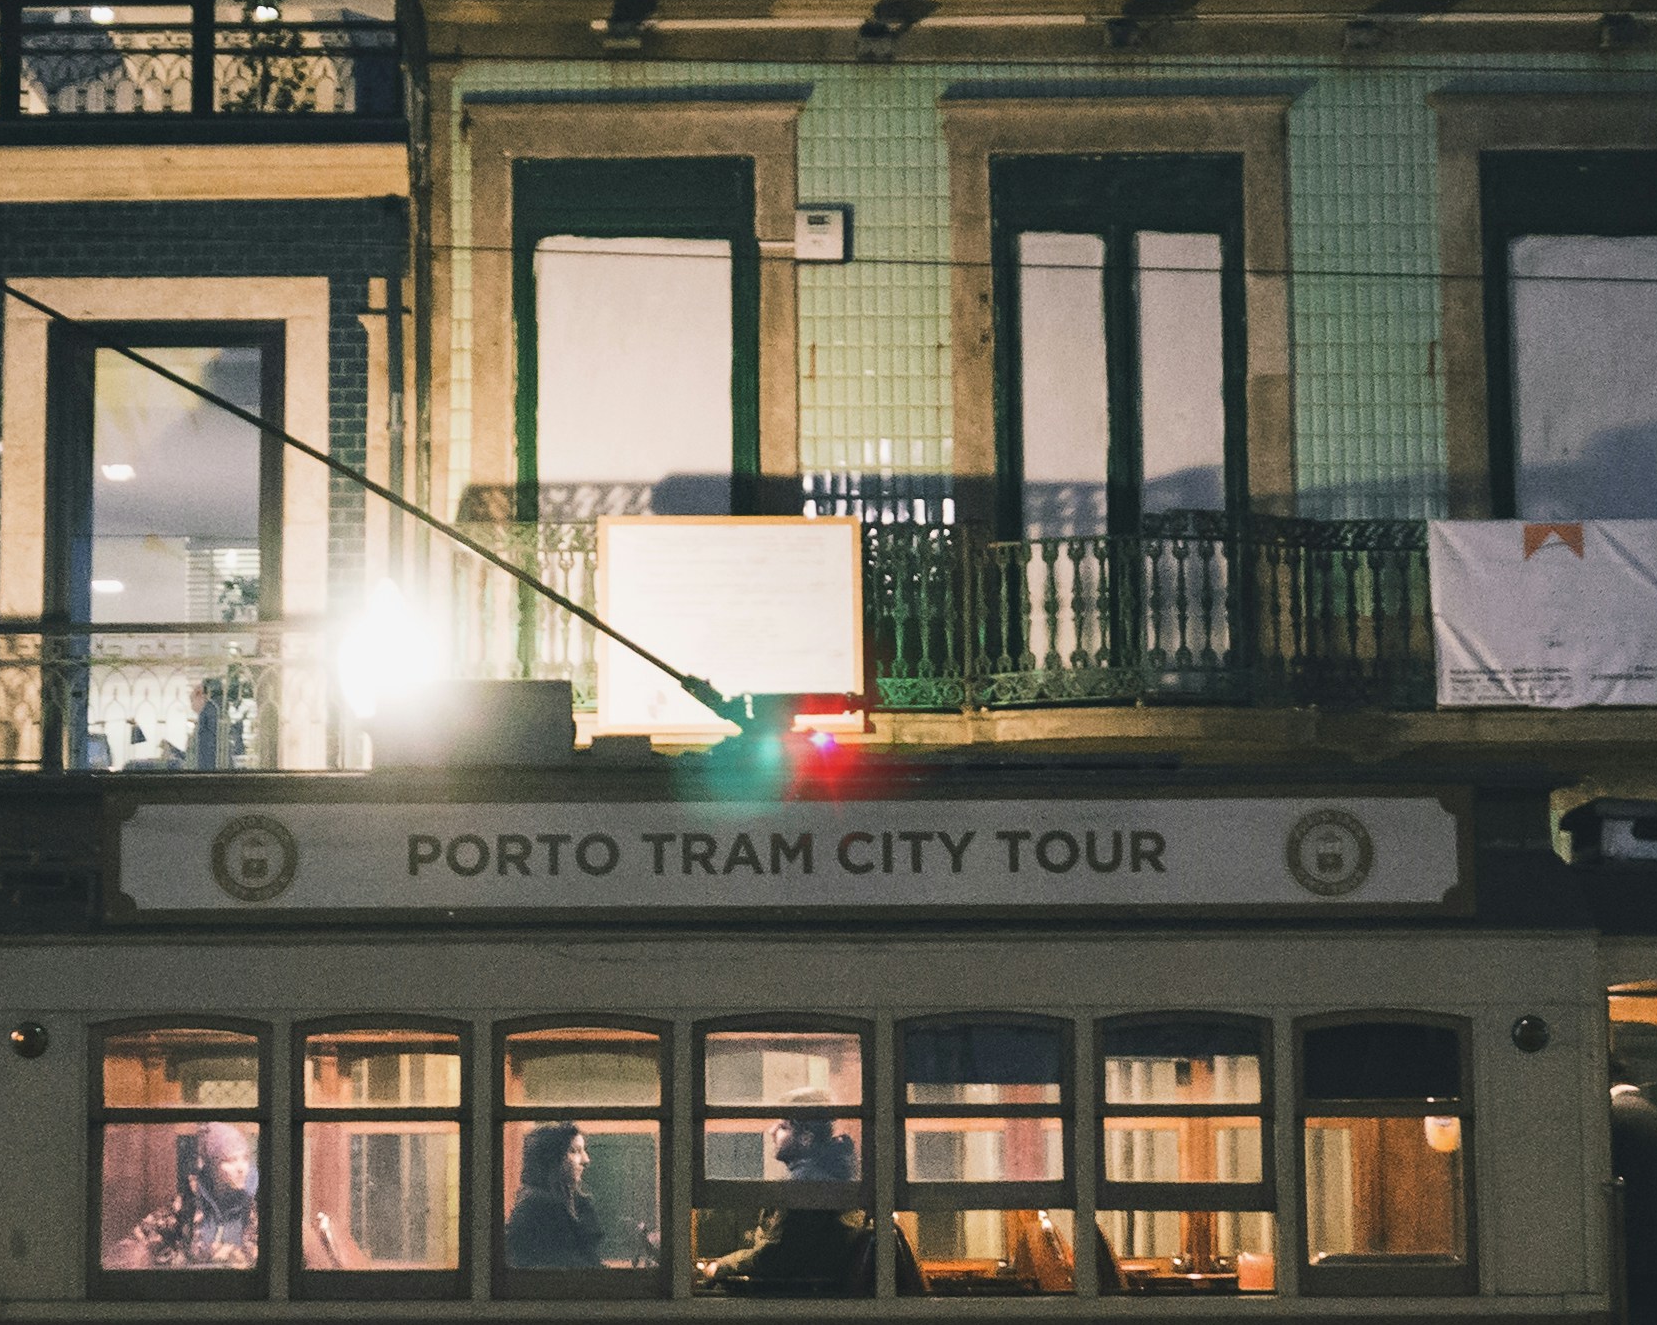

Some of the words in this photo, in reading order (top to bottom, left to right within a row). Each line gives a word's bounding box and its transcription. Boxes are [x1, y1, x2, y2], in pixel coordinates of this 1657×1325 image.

[406, 832, 621, 879] PORTO
[640, 830, 815, 877] TRAM
[836, 829, 977, 876] CITY
[994, 828, 1168, 875] TOUR
